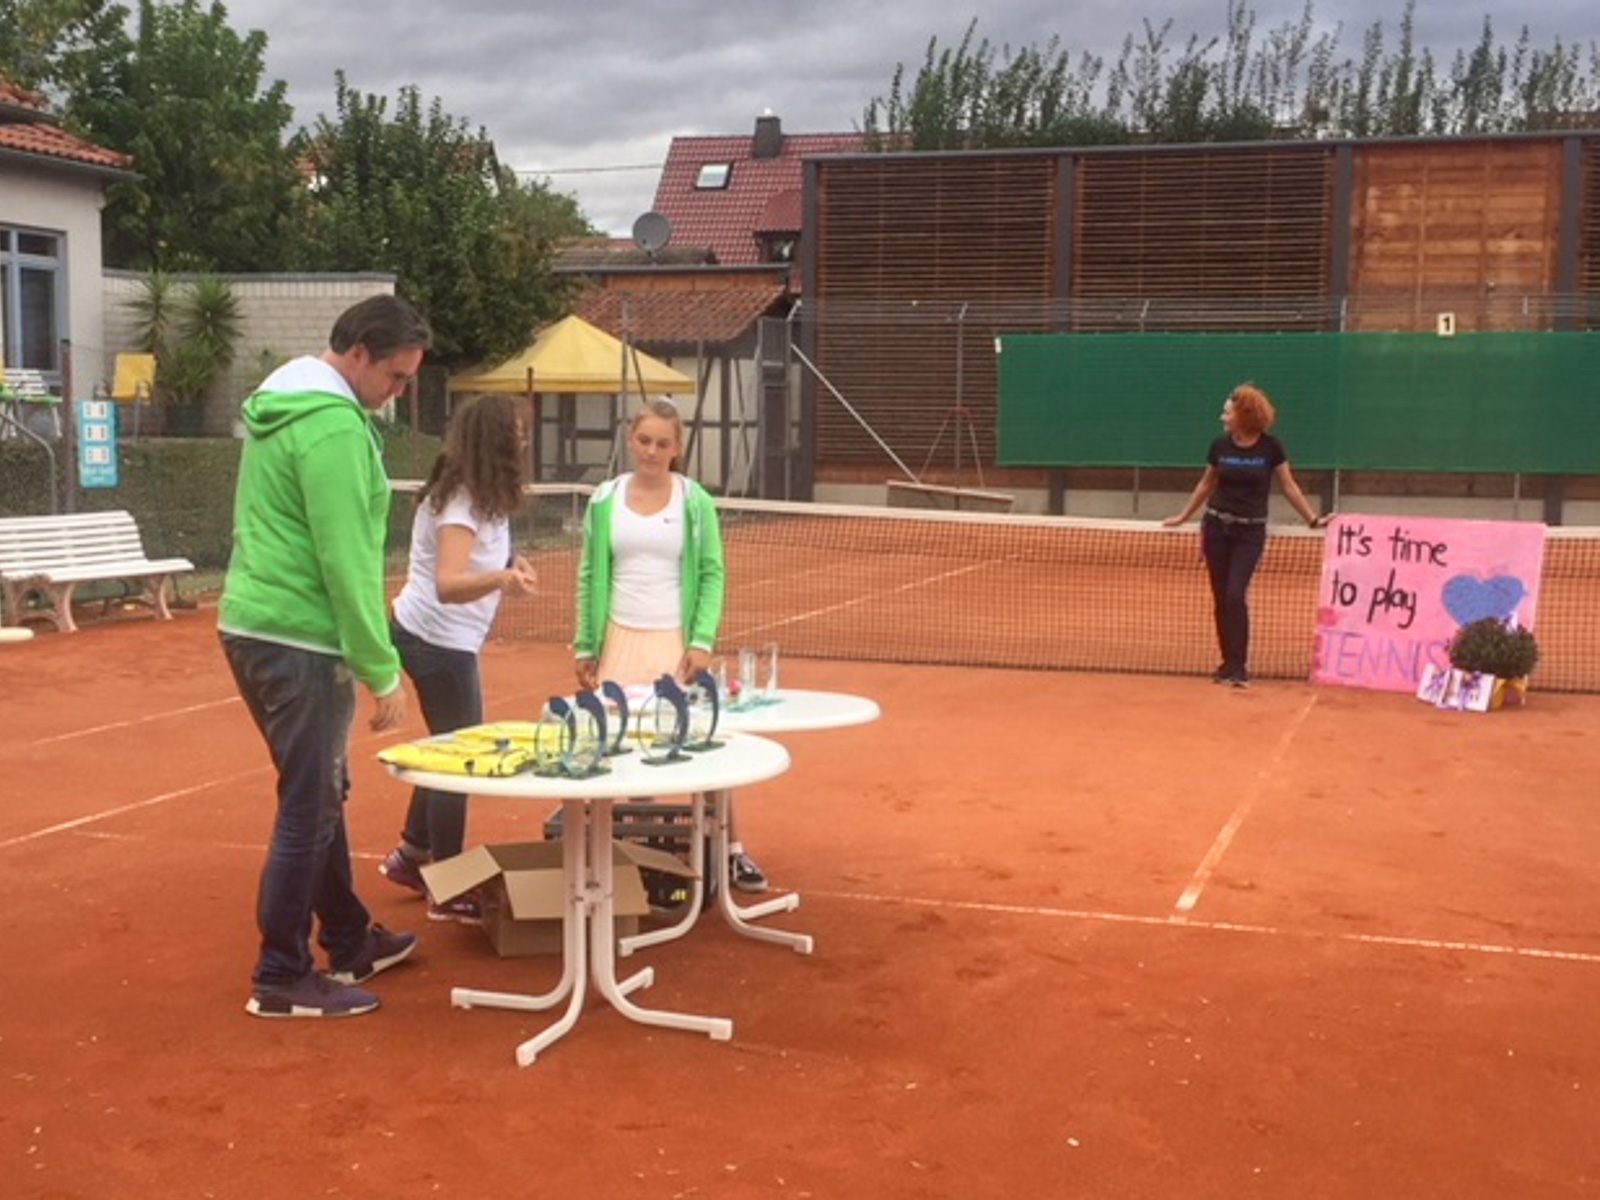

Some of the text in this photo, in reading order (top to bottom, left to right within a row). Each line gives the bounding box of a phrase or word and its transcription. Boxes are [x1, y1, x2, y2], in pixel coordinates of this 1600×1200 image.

[1442, 315, 1451, 332] 1
[1337, 523, 1449, 567] It's time
[1330, 568, 1417, 629] to play
[1319, 628, 1449, 684] TENNIS
